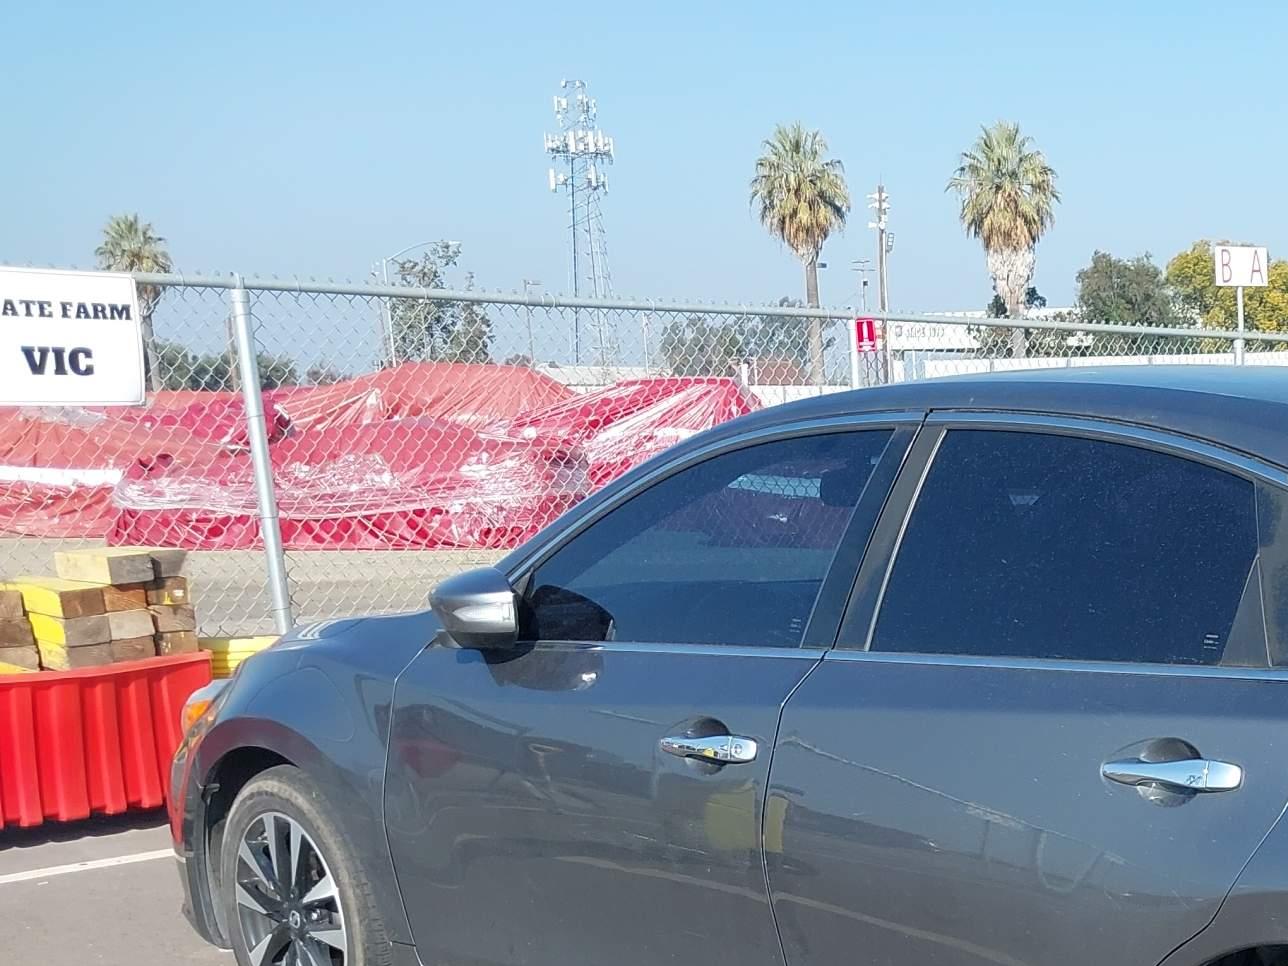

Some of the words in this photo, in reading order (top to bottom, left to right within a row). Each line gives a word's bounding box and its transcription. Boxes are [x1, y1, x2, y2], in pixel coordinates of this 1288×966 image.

[1221, 248, 1232, 283] B
[1250, 249, 1264, 284] A
[1, 299, 53, 318] ATE
[59, 301, 132, 321] FARM
[20, 345, 95, 376] VIC
